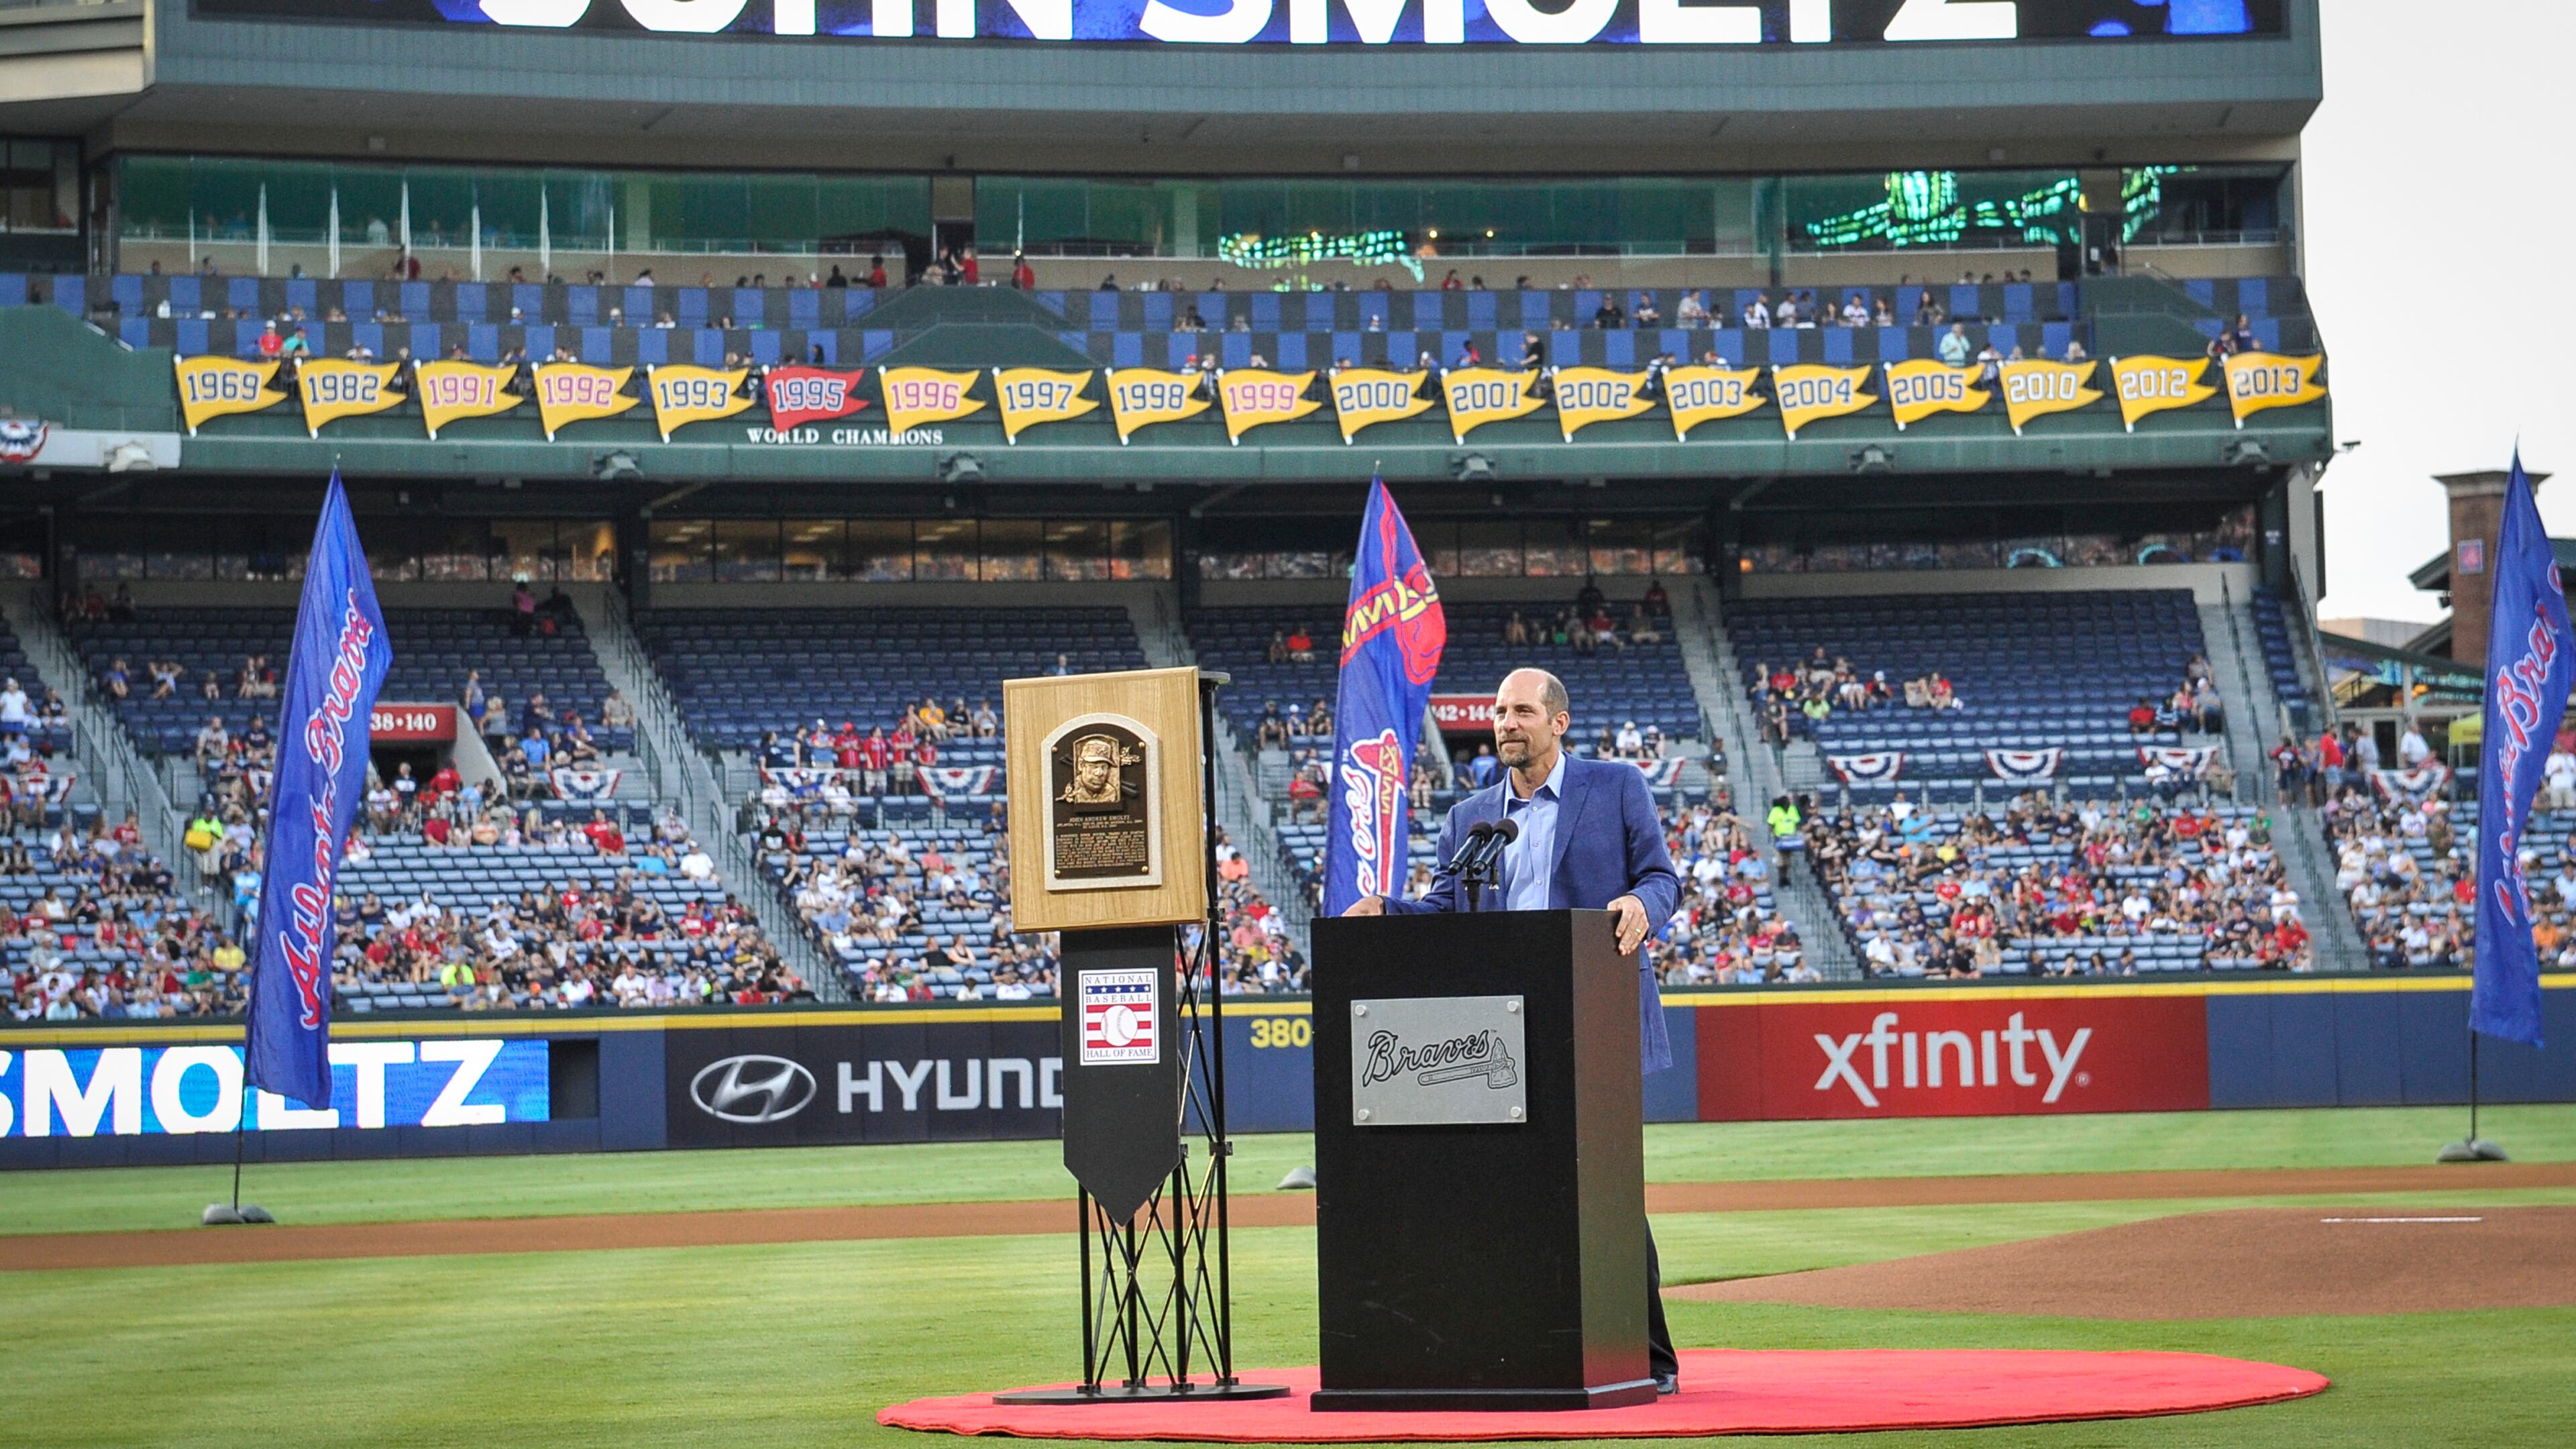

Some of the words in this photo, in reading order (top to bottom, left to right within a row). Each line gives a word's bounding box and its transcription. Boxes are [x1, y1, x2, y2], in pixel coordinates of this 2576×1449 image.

[186, 370, 261, 403] 1969
[306, 374, 380, 406] 1982
[427, 374, 496, 407] 1991
[543, 374, 615, 407] 1992
[659, 379, 731, 411] 1993
[772, 378, 848, 412] 1995
[890, 382, 963, 413] 1996
[1004, 381, 1075, 413] 1997
[1116, 382, 1185, 413] 1998
[1227, 382, 1298, 413] 1999
[1335, 381, 1413, 414] 2000
[1451, 380, 1521, 413] 2001
[1558, 379, 1632, 411] 2002
[1670, 378, 1744, 411] 2003
[1778, 376, 1854, 410] 2004
[1890, 373, 1966, 406] 2005
[2006, 370, 2078, 403] 2010
[2119, 367, 2189, 400] 2012
[2231, 366, 2302, 399] 2013
[747, 427, 819, 444] WORLD
[832, 428, 943, 445] CHAMIONS
[305, 587, 373, 797] Braves
[1085, 975, 1151, 985] NATIONAL
[1085, 994, 1152, 1004] BASEBALL
[1250, 1018, 1311, 1048] 380
[1087, 1049, 1111, 1058] HALL
[1113, 1049, 1125, 1057] OF
[1128, 1048, 1152, 1057] FAME
[1362, 1030, 1489, 1087] Braves
[1814, 1011, 2092, 1108] xfinity
